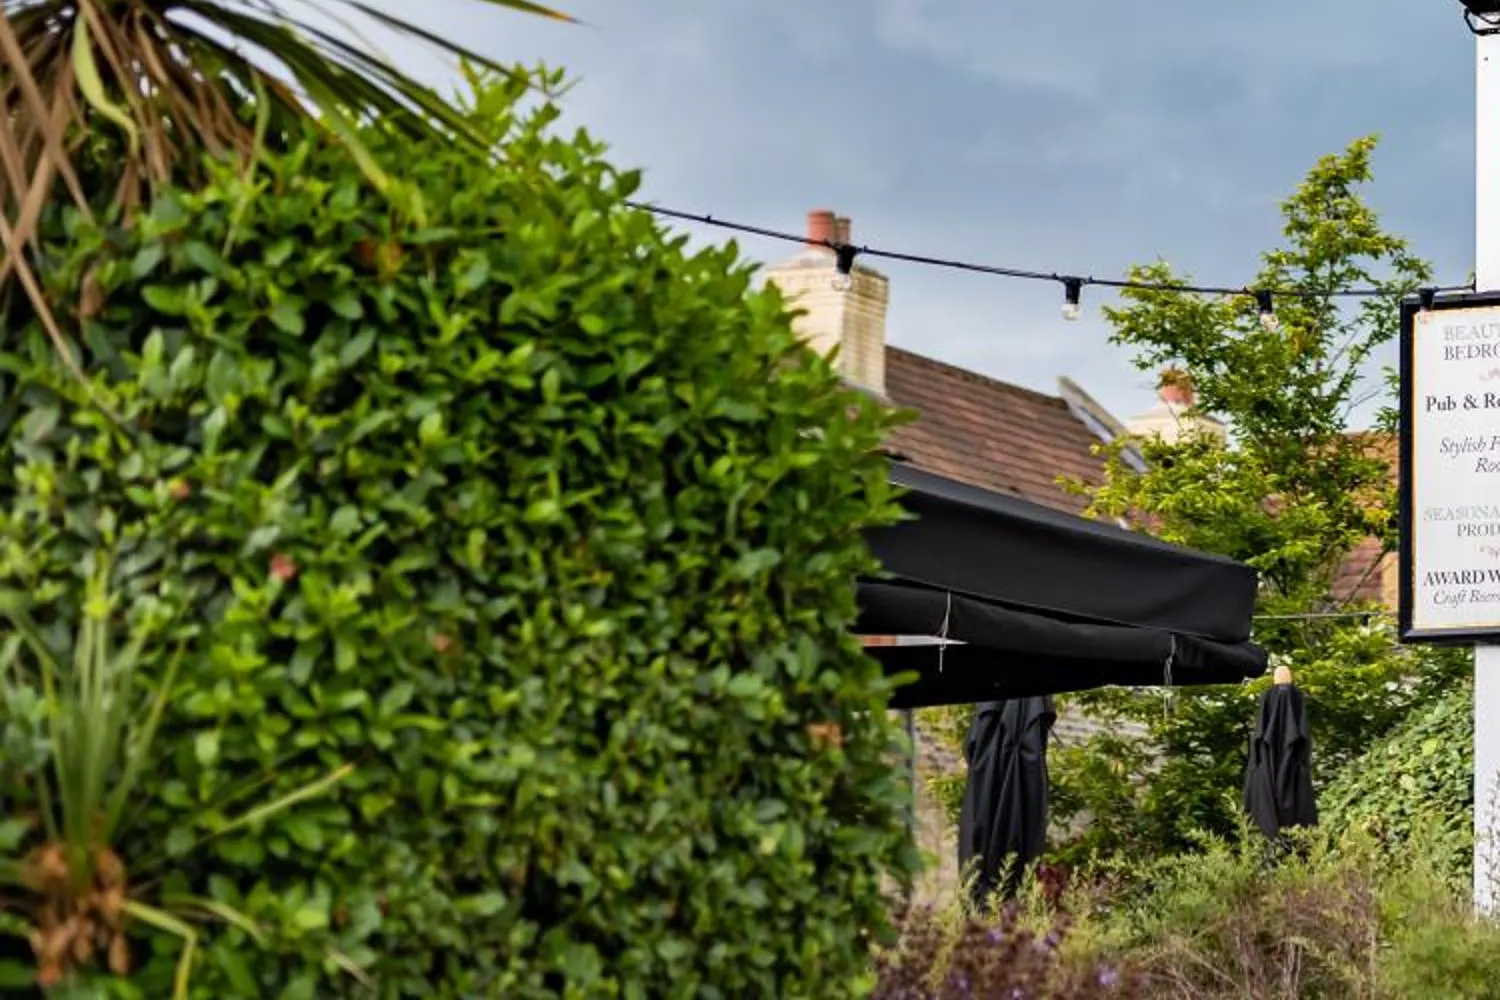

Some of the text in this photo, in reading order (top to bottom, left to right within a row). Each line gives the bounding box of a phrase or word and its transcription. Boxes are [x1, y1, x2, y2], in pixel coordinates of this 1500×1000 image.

[1426, 395, 1457, 412] Pub
[1463, 393, 1479, 410] &
[1439, 435, 1487, 459] Stylish
[1423, 568, 1485, 587] AWARD
[1433, 588, 1467, 608] Craft
